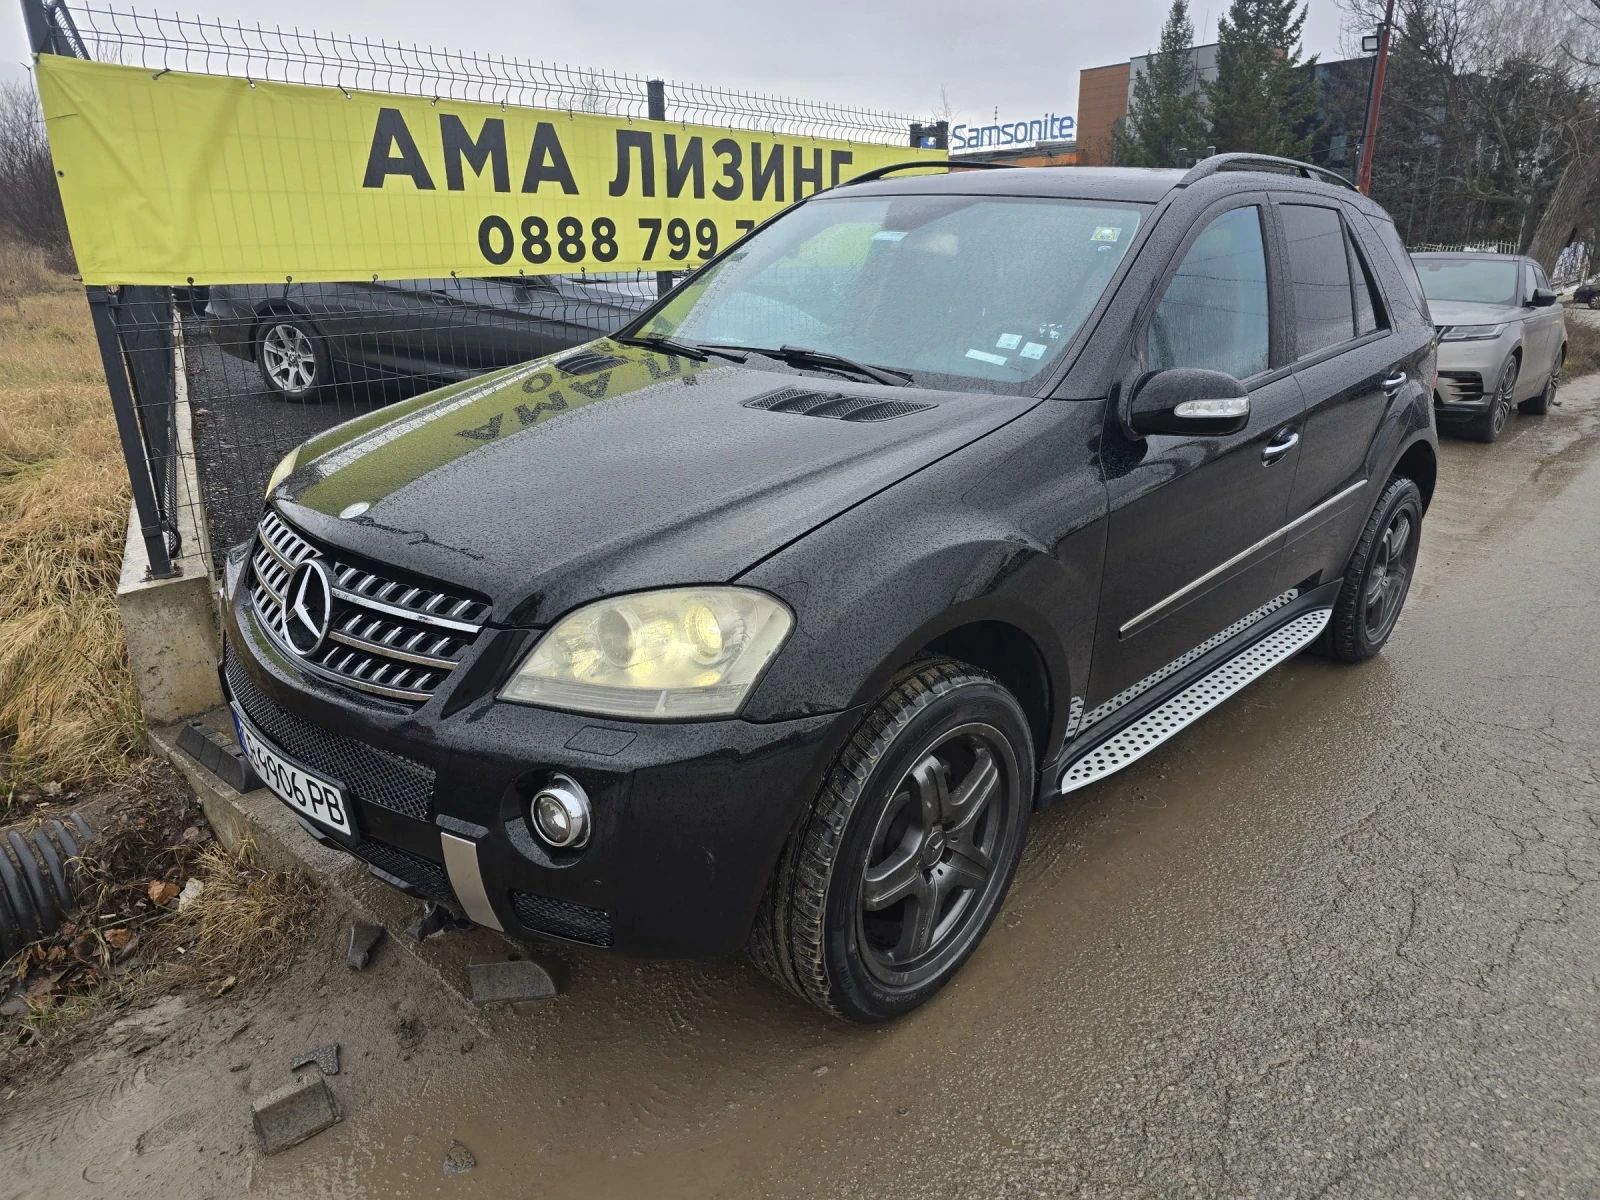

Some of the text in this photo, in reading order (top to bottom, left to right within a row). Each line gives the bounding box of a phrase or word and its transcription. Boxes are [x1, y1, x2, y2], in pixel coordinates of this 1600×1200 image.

[362, 107, 853, 202] АМА ЛИЗИНГ
[952, 112, 1074, 150] Samsonite
[478, 215, 719, 264] 0888 799
